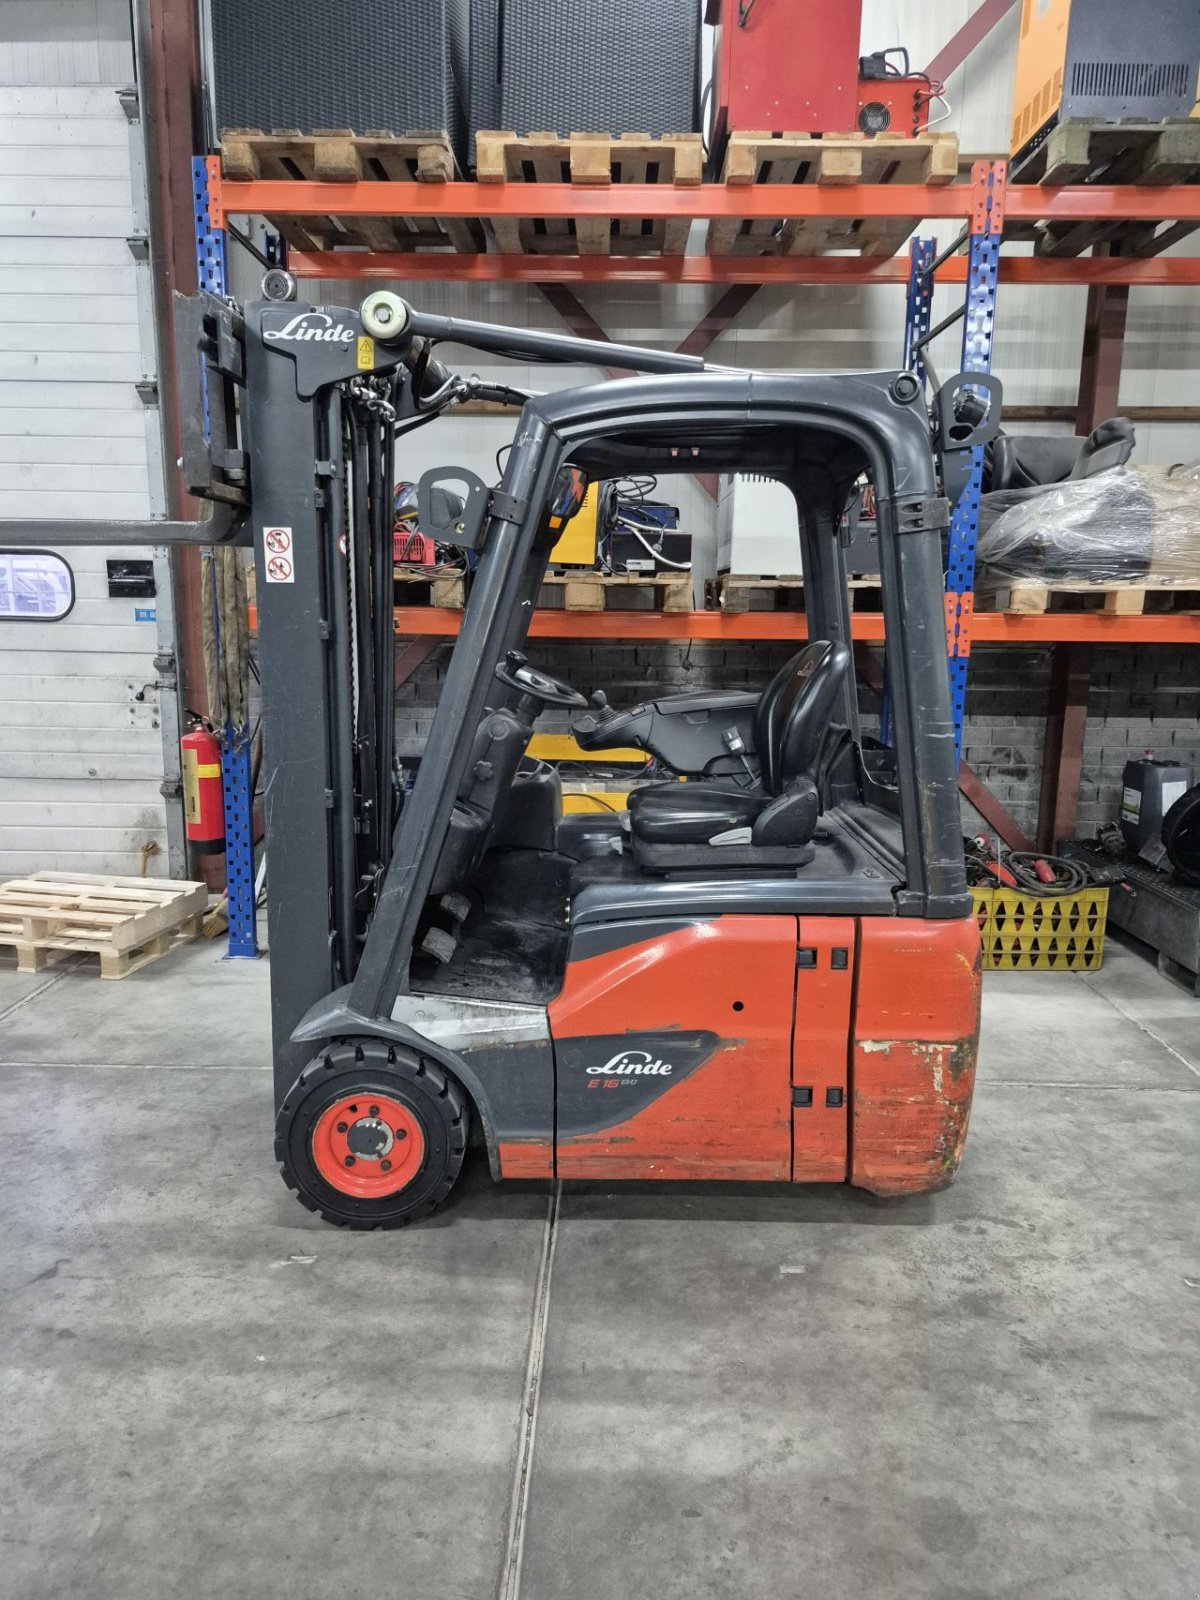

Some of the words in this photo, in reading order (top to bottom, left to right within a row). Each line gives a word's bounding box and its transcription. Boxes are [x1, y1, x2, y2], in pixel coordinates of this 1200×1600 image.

[263, 313, 354, 342] Linde
[586, 1051, 672, 1075] Linde
[587, 1079, 600, 1088] E
[603, 1079, 619, 1088] 16
